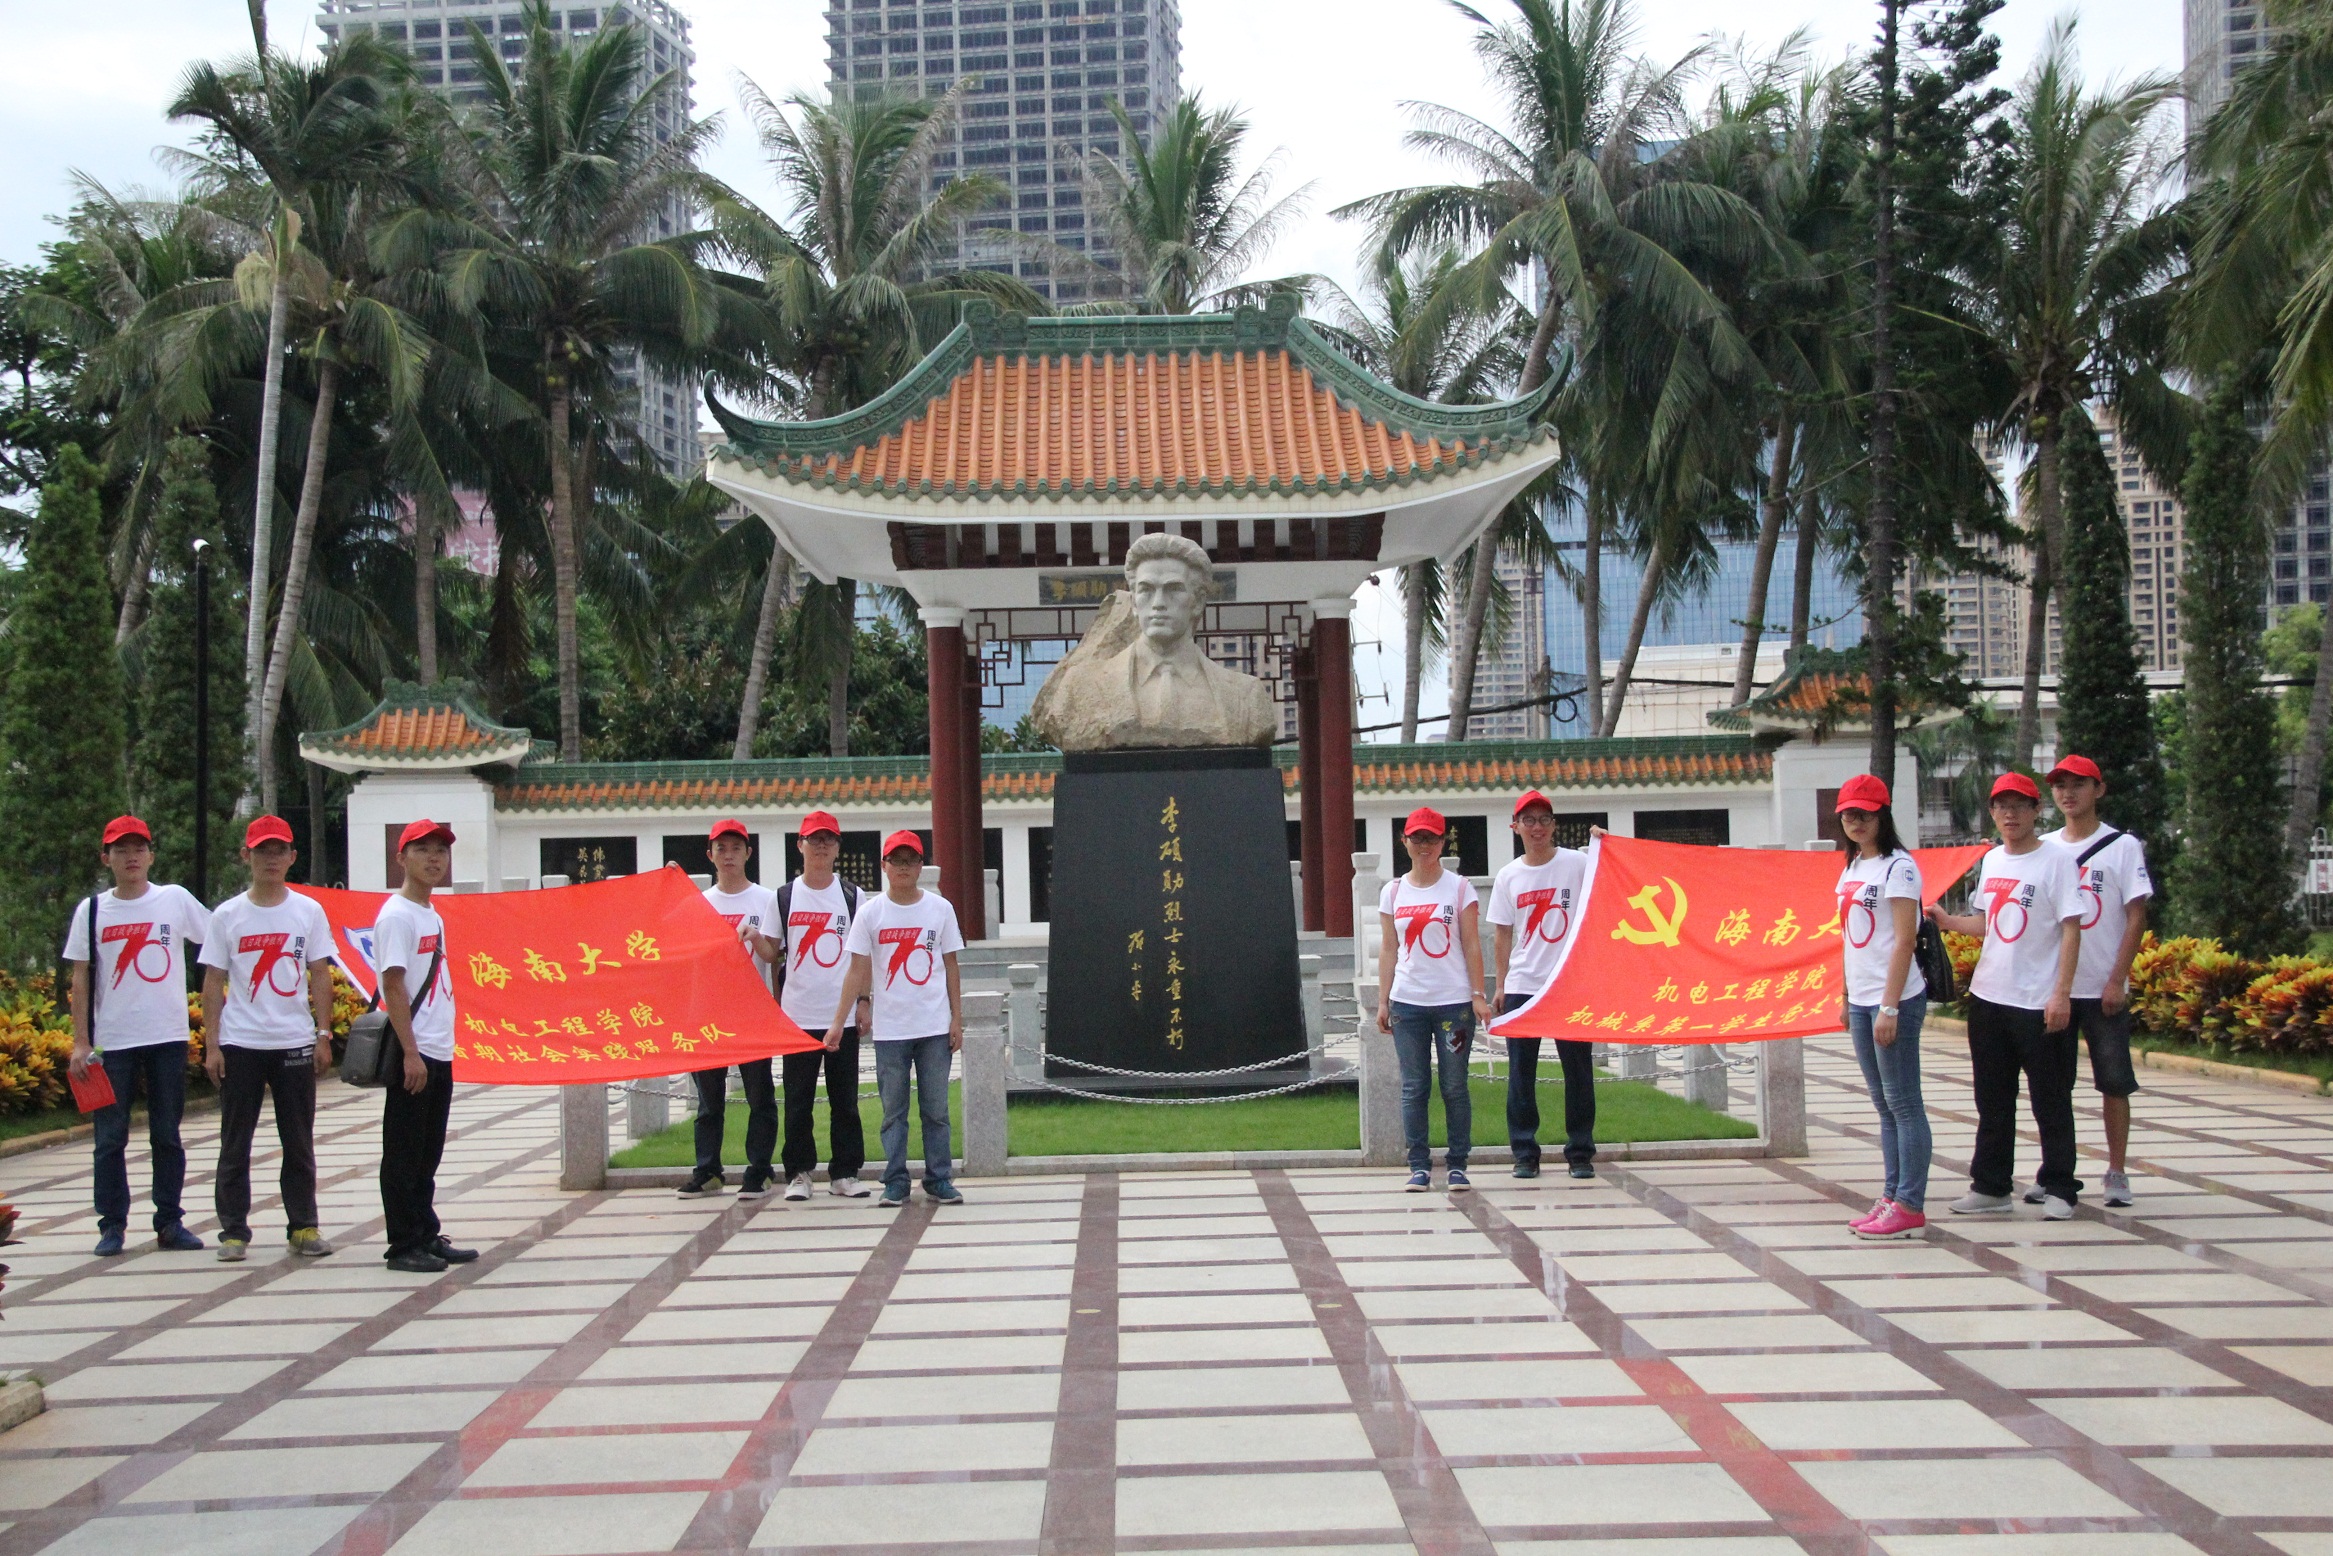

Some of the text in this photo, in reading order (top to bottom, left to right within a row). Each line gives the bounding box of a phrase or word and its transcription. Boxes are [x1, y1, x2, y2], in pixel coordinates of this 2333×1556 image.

[2091, 869, 2104, 895] 周年
[1560, 888, 1571, 911] 周年
[1863, 884, 1878, 910] 周年
[2020, 883, 2036, 909] 周年
[836, 914, 847, 937] 周年
[1443, 904, 1454, 926] 周年
[160, 924, 171, 947] 周年
[293, 936, 306, 961] 周年
[926, 929, 937, 953] 周年
[101, 922, 171, 991] 70
[237, 932, 301, 1004] 70
[468, 929, 661, 990] 海南大学
[1651, 963, 1827, 1005] 机电工程学院
[464, 1001, 665, 1038] 机电工程学院
